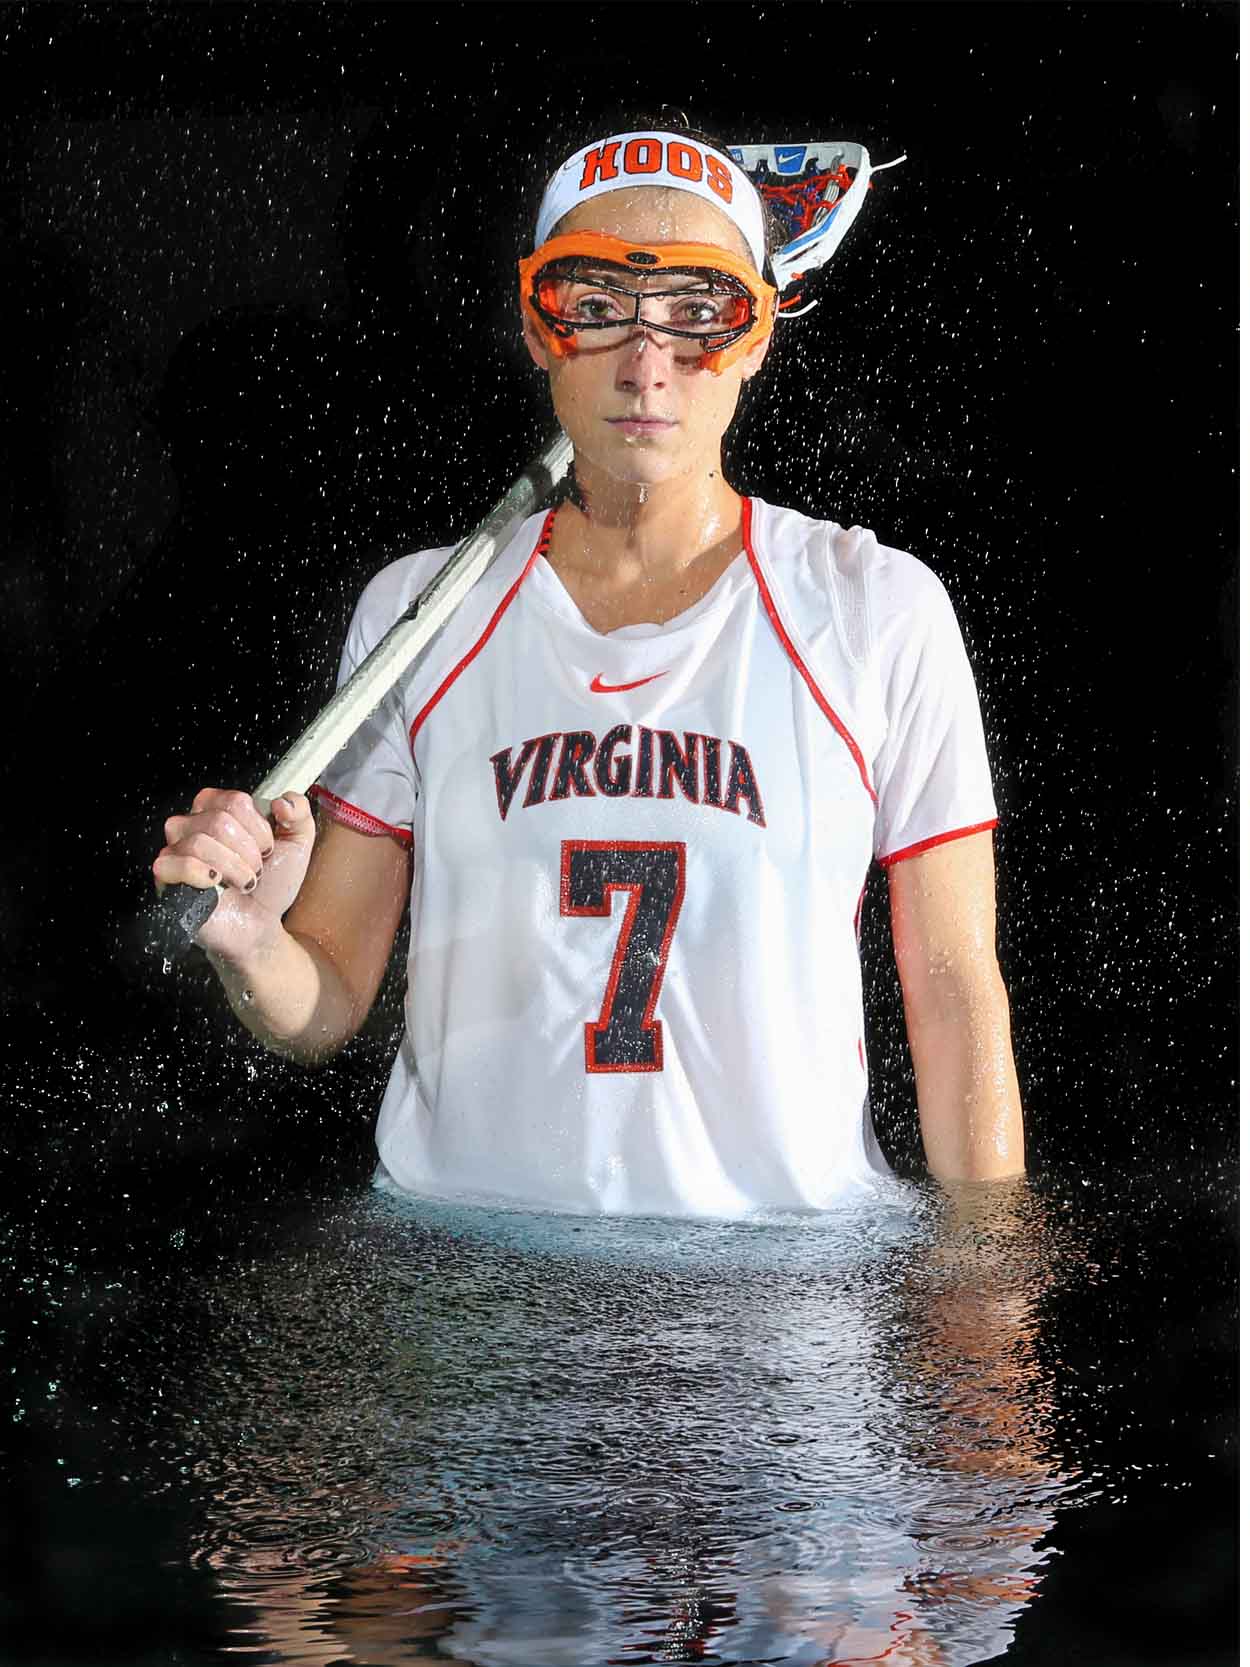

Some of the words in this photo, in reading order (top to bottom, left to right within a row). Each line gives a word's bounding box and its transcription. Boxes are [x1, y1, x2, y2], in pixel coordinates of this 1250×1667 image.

[579, 138, 733, 204] HOOS
[489, 724, 767, 828] VIRGINIA
[560, 840, 687, 1073] 7
